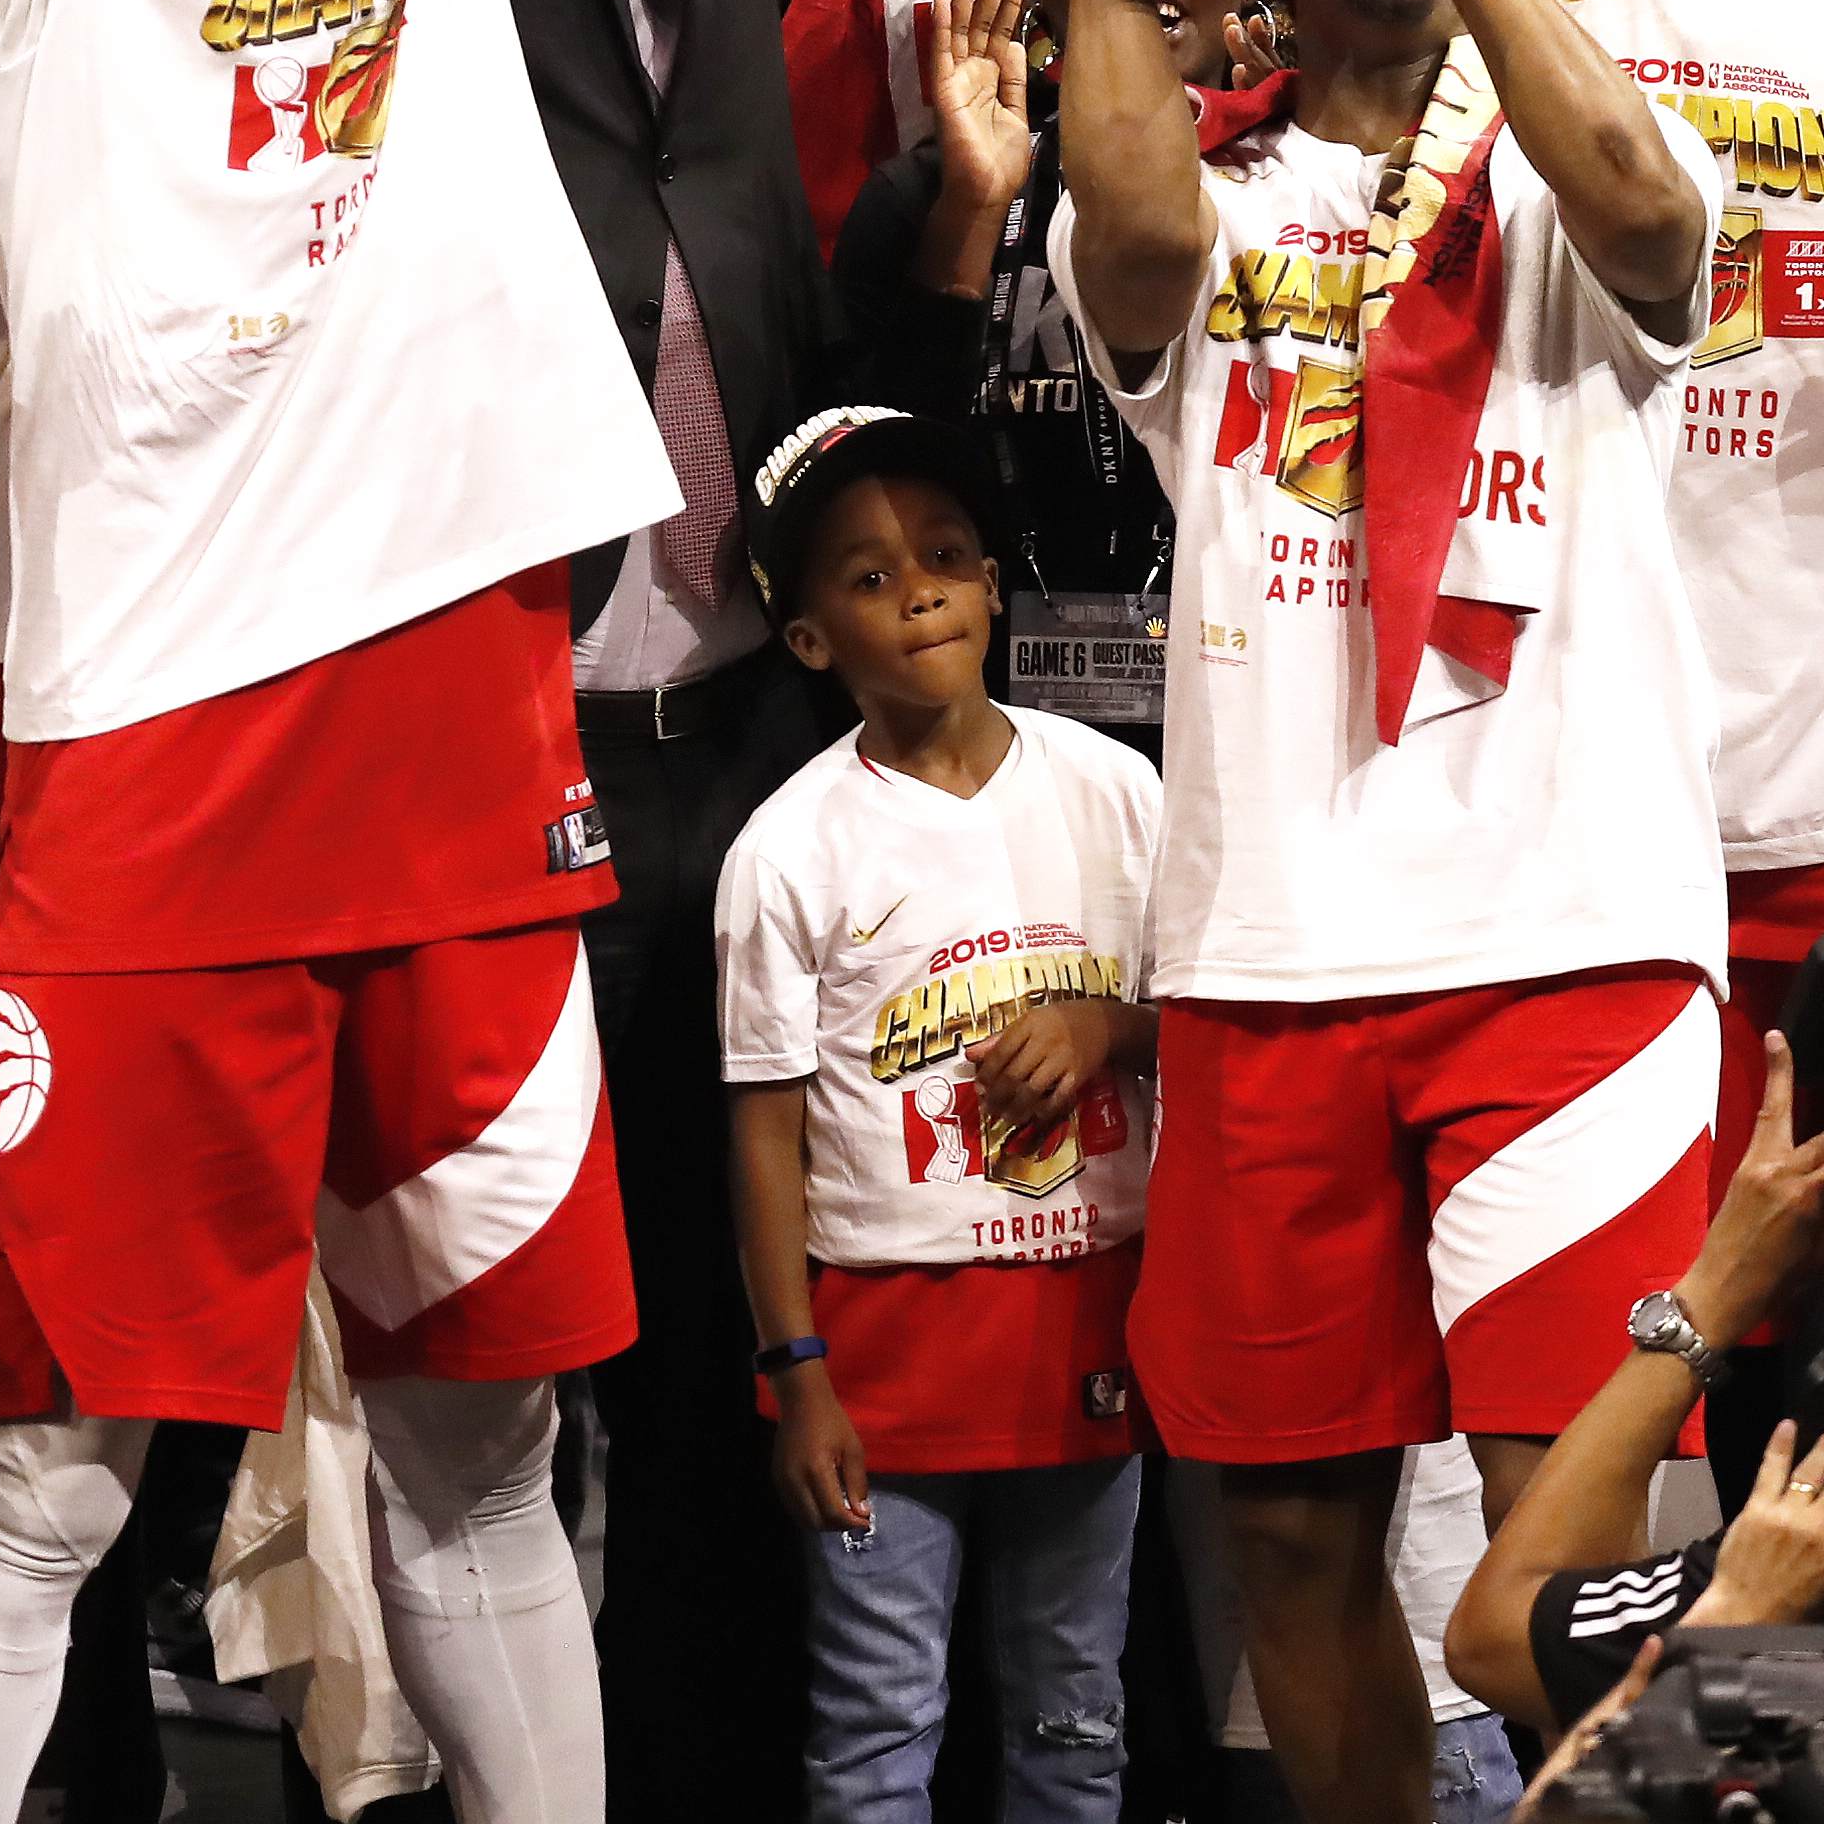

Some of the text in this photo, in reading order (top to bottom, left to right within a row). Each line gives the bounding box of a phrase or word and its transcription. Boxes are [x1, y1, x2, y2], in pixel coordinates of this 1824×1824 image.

[1616, 57, 1787, 87] 2019 NATIONAL
[1723, 72, 1806, 91] BASKETBALL
[1722, 81, 1810, 100] ASSOCIATION
[1275, 222, 1370, 256] 2019
[1099, 432, 1118, 485] DKNY
[1683, 423, 1776, 460] TORS
[1016, 640, 1070, 677] GAME
[1073, 641, 1087, 677] 6
[1092, 641, 1129, 665] GUEST
[1133, 642, 1166, 666] PASS
[929, 922, 1071, 975] 2019 NATIONAL
[1024, 930, 1084, 940] BASKETBALL
[1026, 938, 1088, 948] ASSOCIATION
[971, 1203, 1100, 1248] TORONTO
